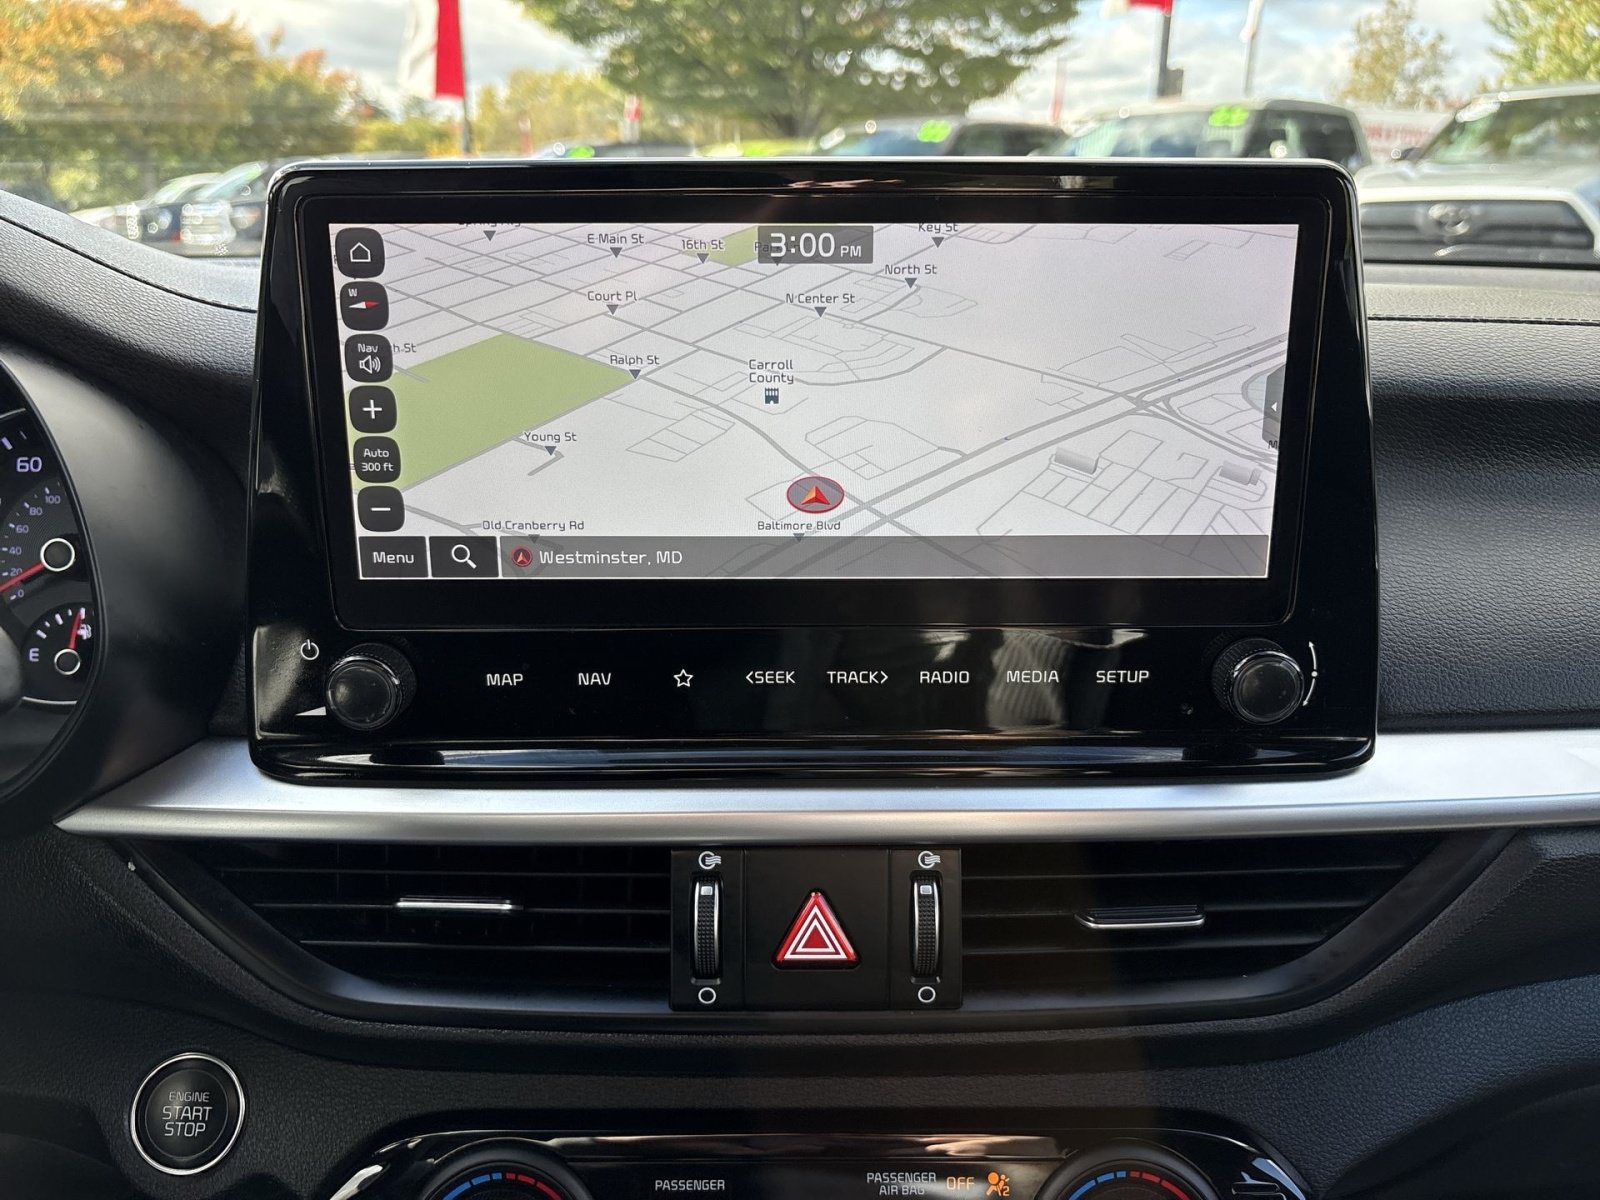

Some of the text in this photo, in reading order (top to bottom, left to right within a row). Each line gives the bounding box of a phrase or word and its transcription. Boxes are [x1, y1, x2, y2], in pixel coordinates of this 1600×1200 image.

[918, 222, 959, 234] Key St
[587, 233, 645, 244] E Main St
[682, 239, 725, 250] 16th St
[769, 232, 862, 258] 3:00 PM
[884, 264, 938, 275] North St
[348, 288, 358, 297] W
[587, 291, 638, 302] Court Pl
[785, 293, 856, 304] N Center St
[357, 343, 379, 353] Nav
[403, 343, 417, 353] St
[609, 355, 660, 367] Ralph St
[748, 359, 793, 370] Carroll
[749, 373, 794, 385] County
[524, 432, 577, 443] Young St
[363, 448, 390, 458] Auto
[16, 457, 42, 472] 60
[361, 462, 394, 472] 300 ft
[45, 495, 61, 504] 100
[29, 507, 42, 516] 80
[16, 525, 29, 533] 60
[482, 520, 585, 531] Old Cranberry Rd
[757, 520, 841, 531] Baltimore Blvd
[9, 547, 22, 555] 40
[372, 551, 415, 565] Menu
[656, 550, 683, 565] MD
[18, 589, 25, 598] 0
[29, 648, 39, 661] E
[486, 673, 523, 686] MAP
[578, 672, 612, 686] NAV
[919, 670, 970, 684] RADIO
[1006, 670, 1060, 683] MEDIA
[1096, 670, 1149, 683] SETUP
[168, 1091, 211, 1102] ENGINE
[162, 1105, 213, 1121] START
[164, 1121, 206, 1137] STOP
[866, 1172, 937, 1184] PASSENGER
[946, 1176, 975, 1190] OFF
[655, 1179, 726, 1192] PASSENGER
[879, 1184, 926, 1196] AIR BAG
